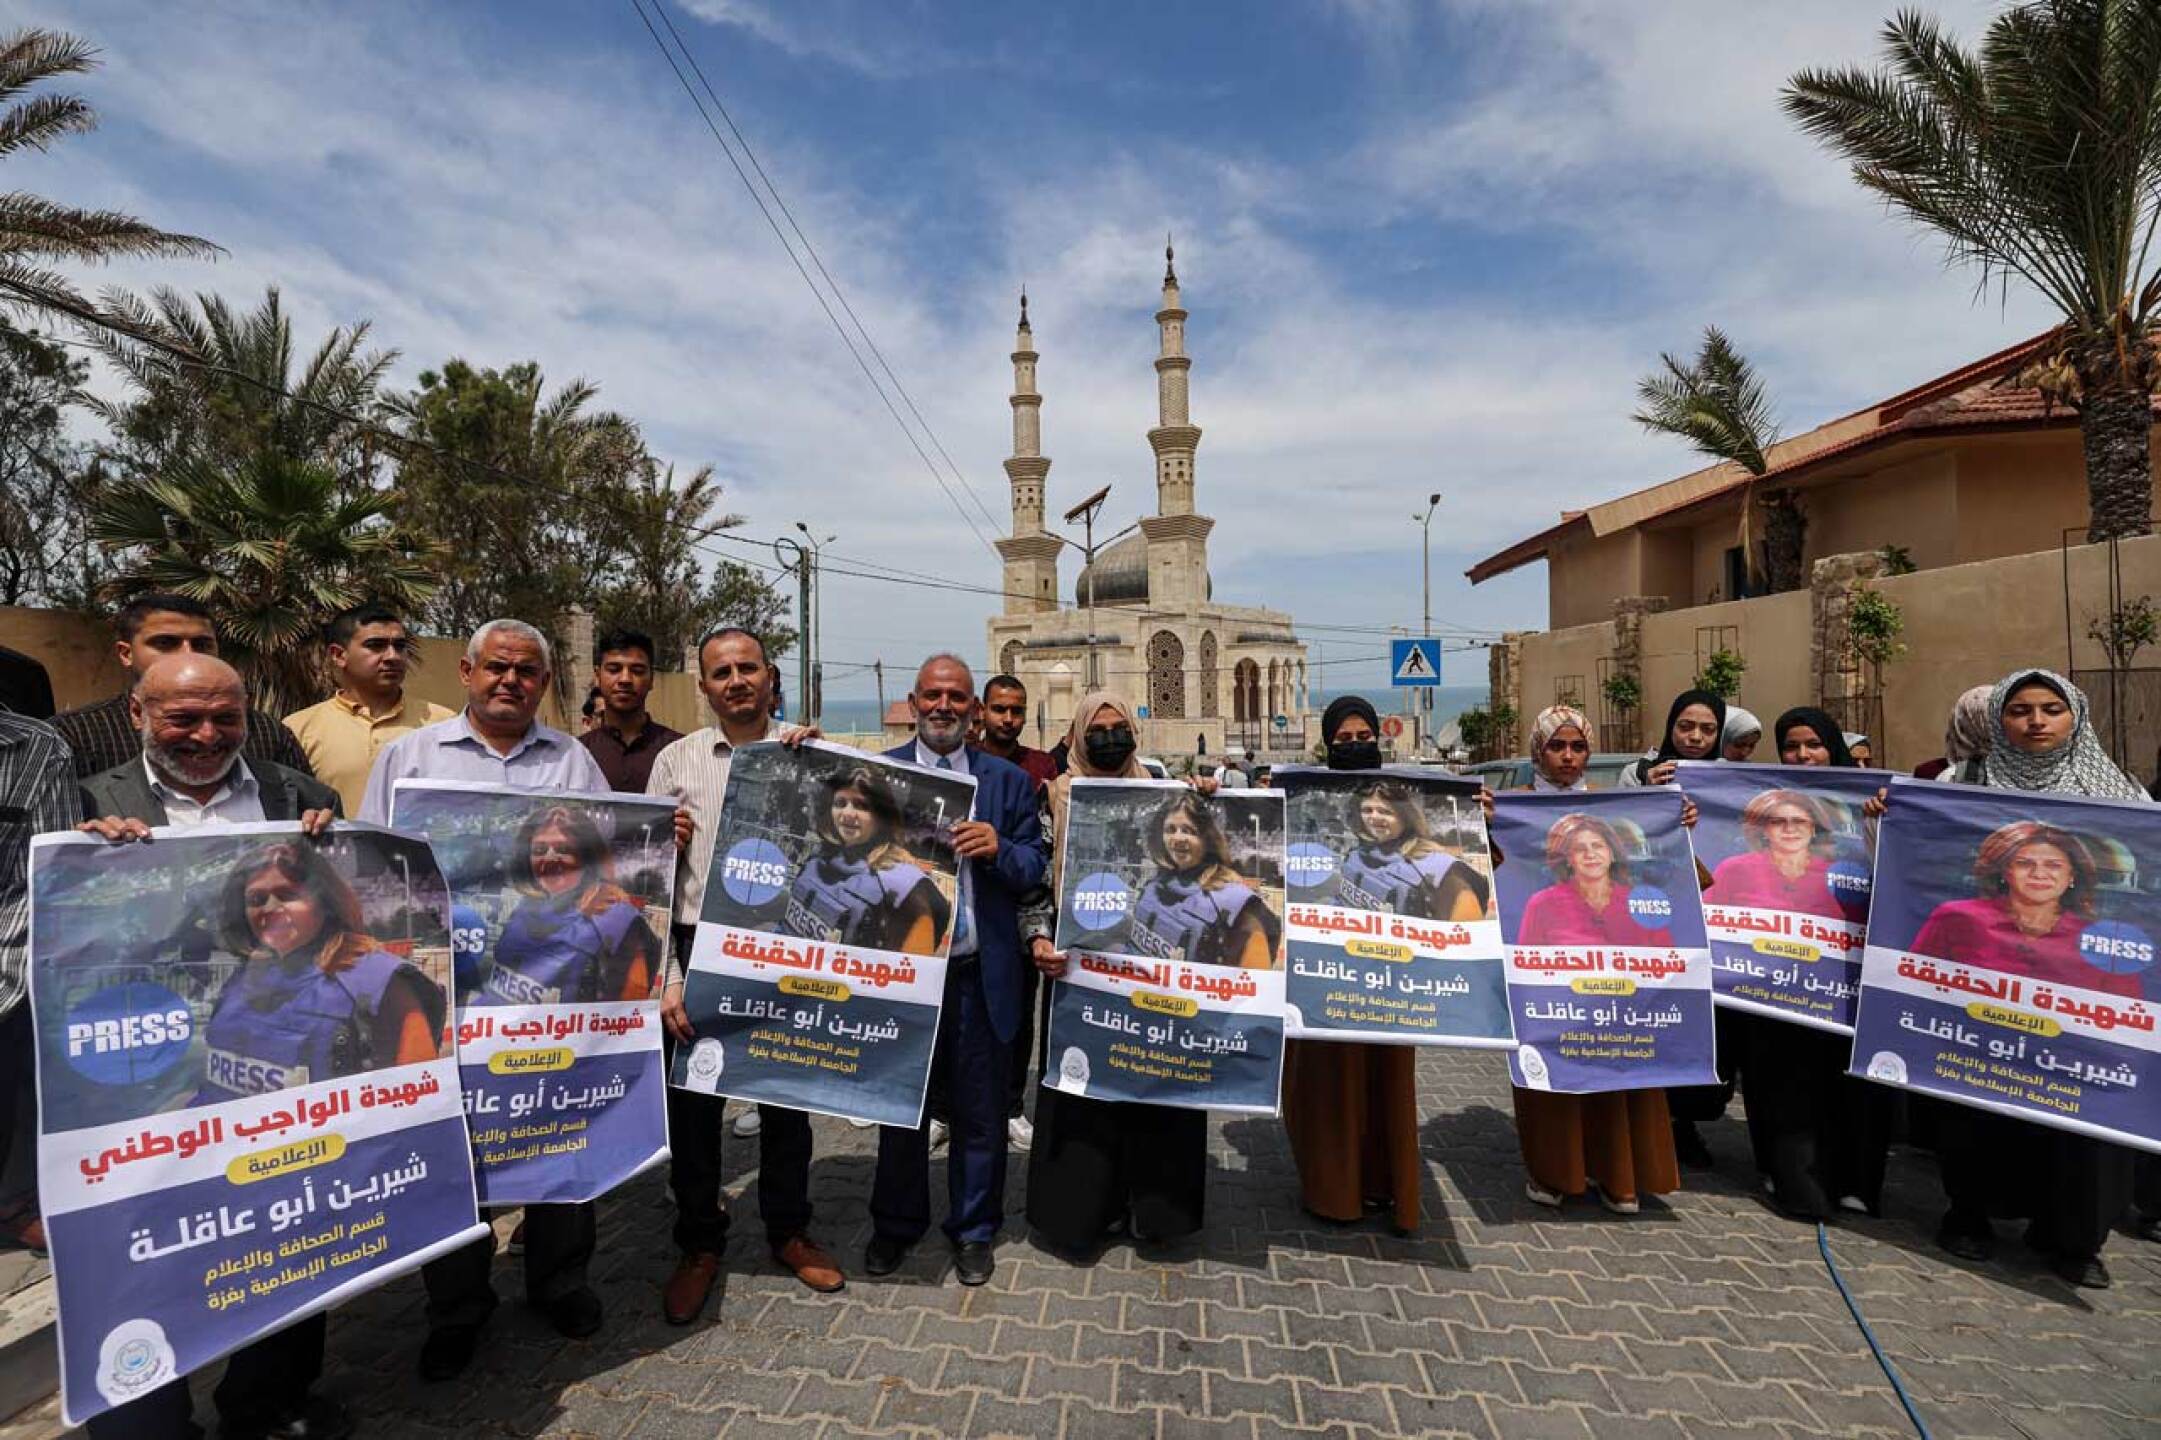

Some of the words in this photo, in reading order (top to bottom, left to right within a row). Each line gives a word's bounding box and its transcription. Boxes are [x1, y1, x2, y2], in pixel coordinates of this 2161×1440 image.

[725, 857, 786, 886] PRESS
[1286, 856, 1333, 872] RESS
[1075, 891, 1127, 911] PRESS
[1629, 898, 1672, 916] PRESS
[1288, 907, 1381, 936] الحقيقة
[1390, 919, 1471, 950] شهيدة
[1705, 908, 1791, 935] الحقيق
[722, 933, 824, 970] الحقيقة
[2081, 933, 2153, 962] PRESS
[831, 951, 916, 986] شهيدة
[1081, 953, 1170, 987] الحقيقة
[1293, 959, 1357, 981] عاقلة
[1514, 950, 1604, 975] الحقيقة
[1612, 951, 1686, 979] شهيدة
[1712, 956, 1766, 977] عاقل
[1772, 964, 1798, 985] أبو
[791, 979, 838, 999] الإعلامية
[1179, 970, 1256, 1001] شهيدة
[1365, 966, 1392, 990] أبو
[1399, 972, 1469, 996] شيرين
[1897, 957, 2021, 1003] الحقيقة
[588, 1008, 645, 1036] شهيدة
[719, 996, 786, 1020] عاقلة
[794, 1004, 823, 1029] أبو
[1082, 1006, 1140, 1035] عاقلة
[1526, 1002, 1587, 1021] عاقلة
[1594, 1000, 1617, 1026] أبو
[1624, 1004, 1681, 1027] شيرين
[1982, 1006, 2045, 1031] الإعلامية
[2031, 985, 2155, 1032] شهيدة
[68, 1009, 190, 1057] PRESS
[501, 1013, 584, 1043] الواجب
[828, 1012, 899, 1042] شيرين
[1147, 1018, 1173, 1044] أبو
[1179, 1029, 1248, 1053] شيرين
[1900, 1012, 1980, 1047] عاقلة
[504, 1053, 562, 1072] الإعلامية
[1988, 1037, 2026, 1061] أبو
[209, 1057, 285, 1093] PRESS
[1990, 1065, 2044, 1088] الصحافة
[2034, 1046, 2137, 1087] شيرين
[358, 1071, 441, 1113] شهيدة
[509, 1079, 545, 1118] أبو
[551, 1074, 625, 1110] شيرين
[2026, 1091, 2080, 1113] الجامعة
[2047, 1080, 2081, 1096] قسم
[234, 1090, 349, 1139] الواجب
[560, 1119, 587, 1134] قسم
[511, 1121, 557, 1138] الصحافة
[79, 1116, 224, 1184] الوطني
[248, 1140, 327, 1177] الإعلامية
[484, 1145, 542, 1164] الإسلامية
[543, 1137, 587, 1154] الجامعة
[328, 1152, 427, 1210] شيرين
[269, 1176, 316, 1233] أبو
[129, 1206, 255, 1263] عاقلة
[348, 1213, 386, 1238] قسم
[279, 1222, 343, 1259] الصحافة
[331, 1238, 388, 1270] الجامعة
[205, 1243, 274, 1286] والإعلام
[250, 1258, 326, 1298] الإسلامية
[208, 1281, 246, 1311] بغزة
